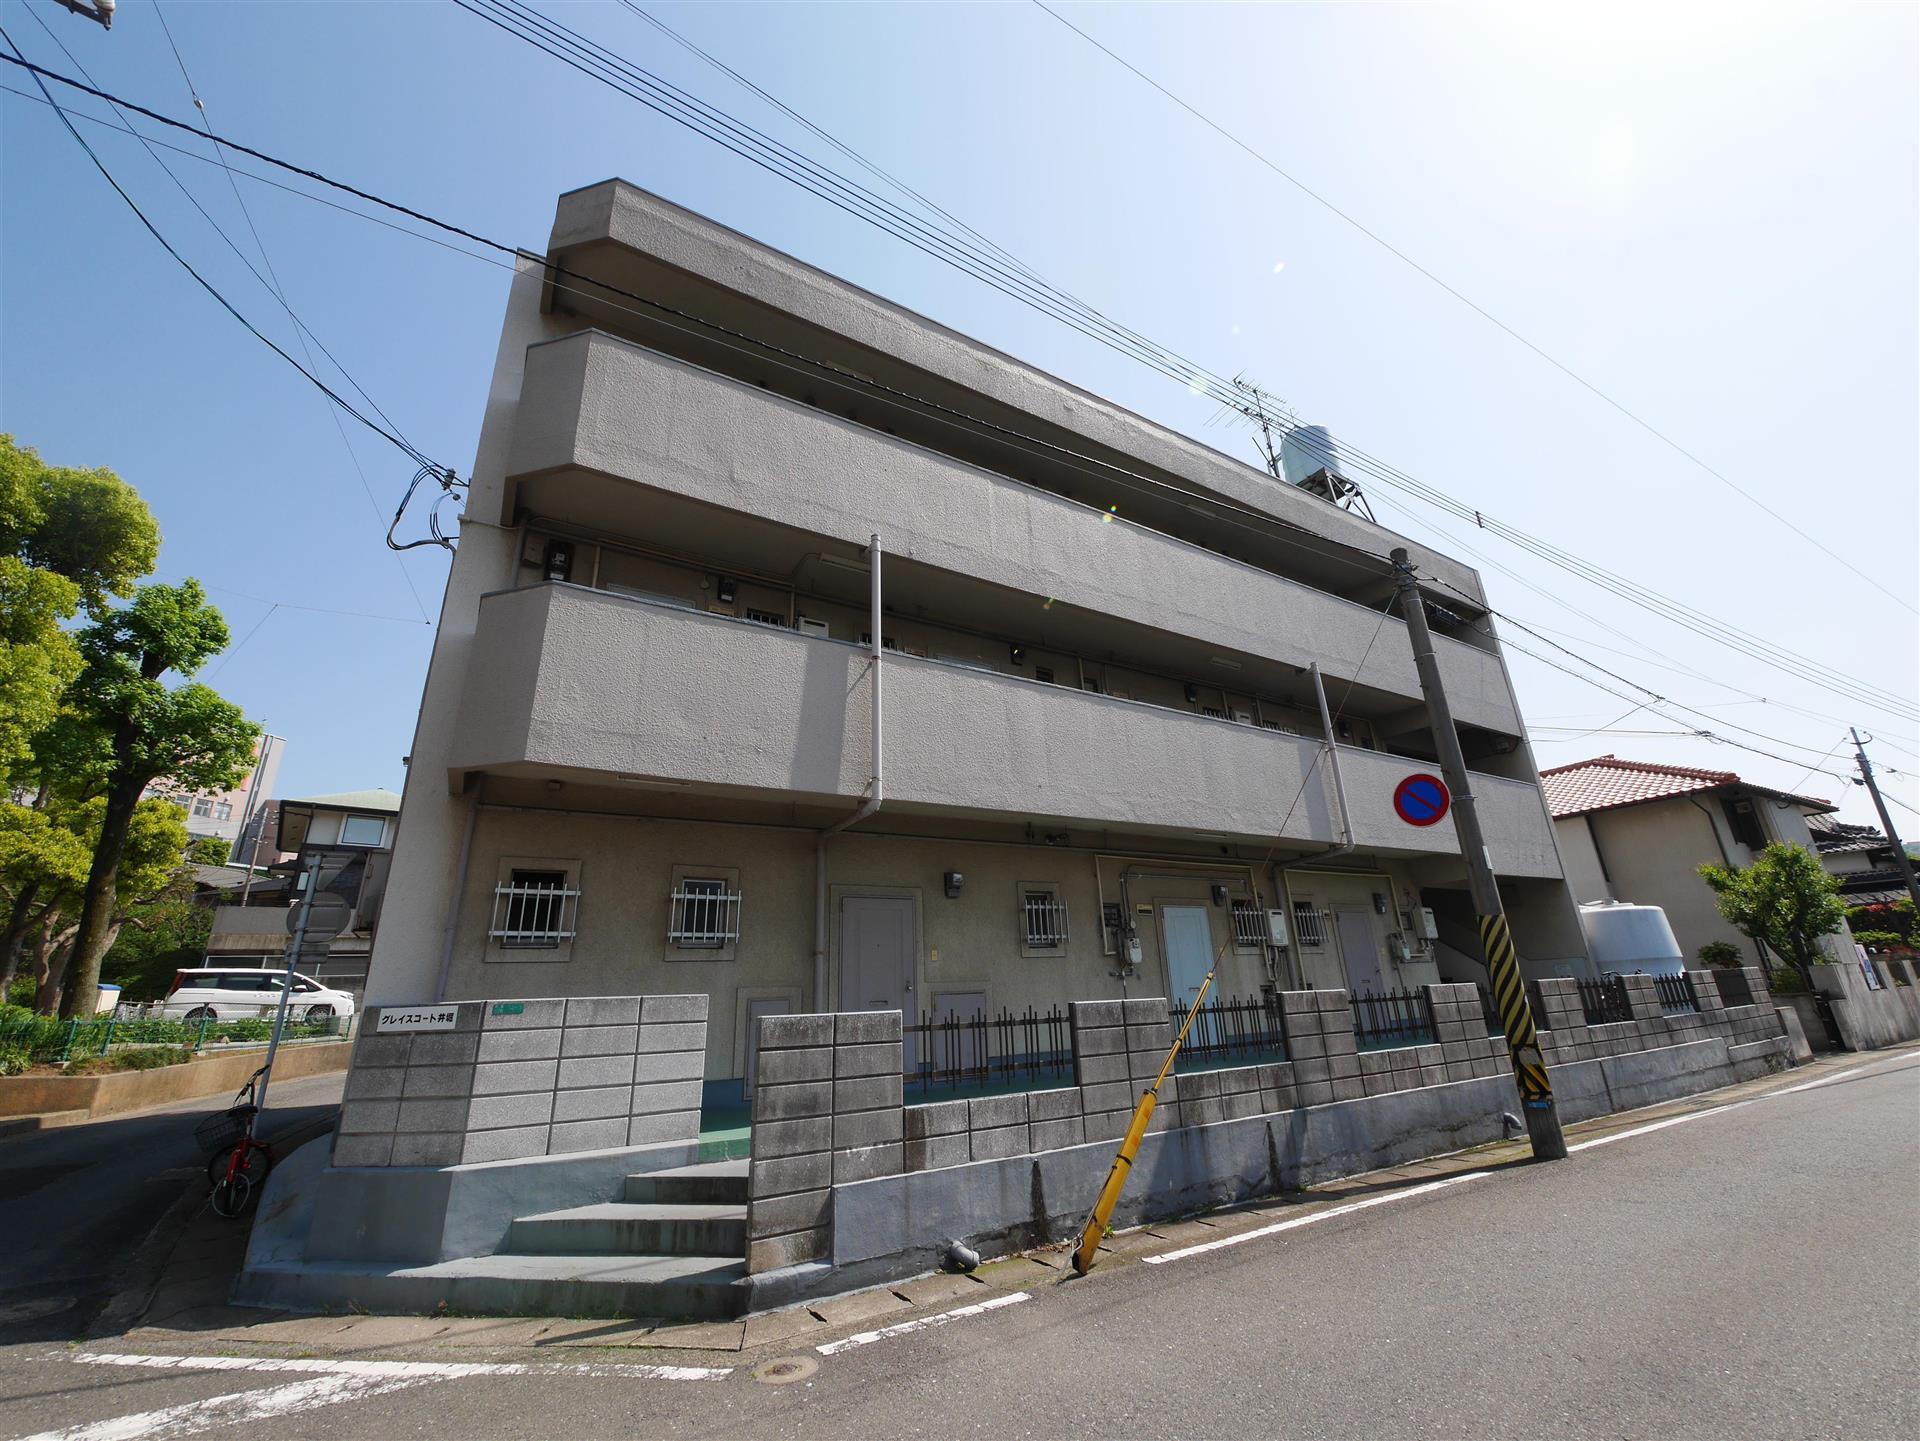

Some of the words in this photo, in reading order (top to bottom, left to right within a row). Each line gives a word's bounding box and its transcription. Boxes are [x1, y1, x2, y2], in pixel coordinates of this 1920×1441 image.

[382, 1012, 454, 1025] グレイスコート井堀
